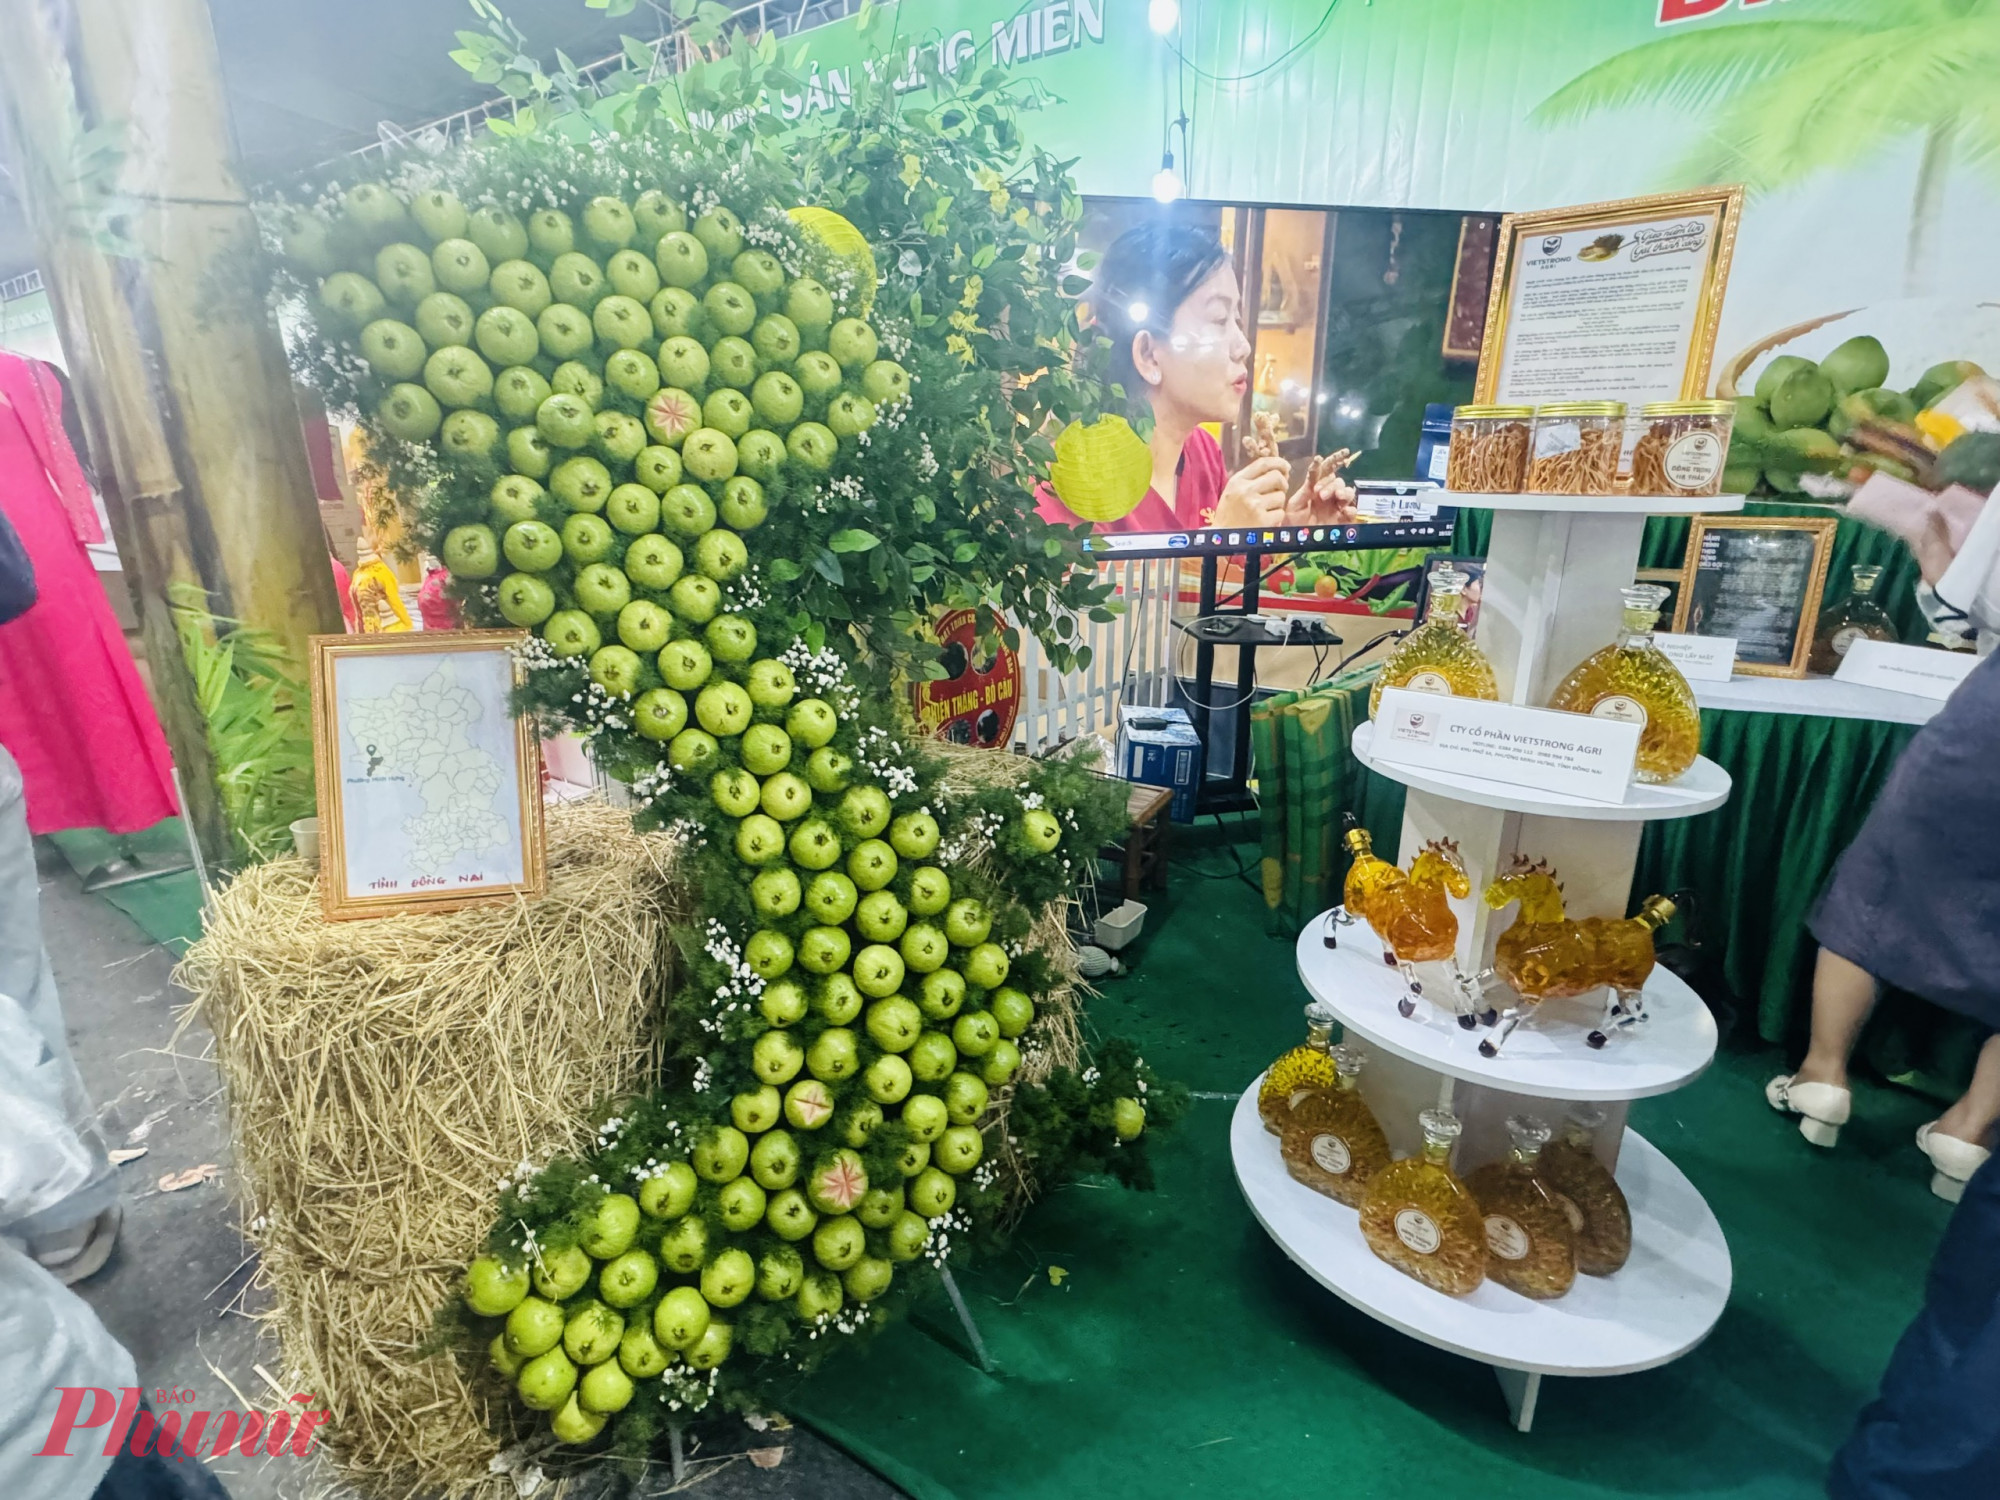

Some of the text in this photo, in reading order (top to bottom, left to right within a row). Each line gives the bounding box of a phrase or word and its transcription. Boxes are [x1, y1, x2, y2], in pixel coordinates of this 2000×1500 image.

[1526, 256, 1572, 267] VIETSTRONG
[1450, 724, 1467, 734] CTY
[1483, 729, 1511, 742] PHẦN
[1513, 735, 1575, 751] VIETSTRONG
[1576, 745, 1602, 756] AGRI
[368, 871, 483, 889] TỈNH ĐỒNG NAI
